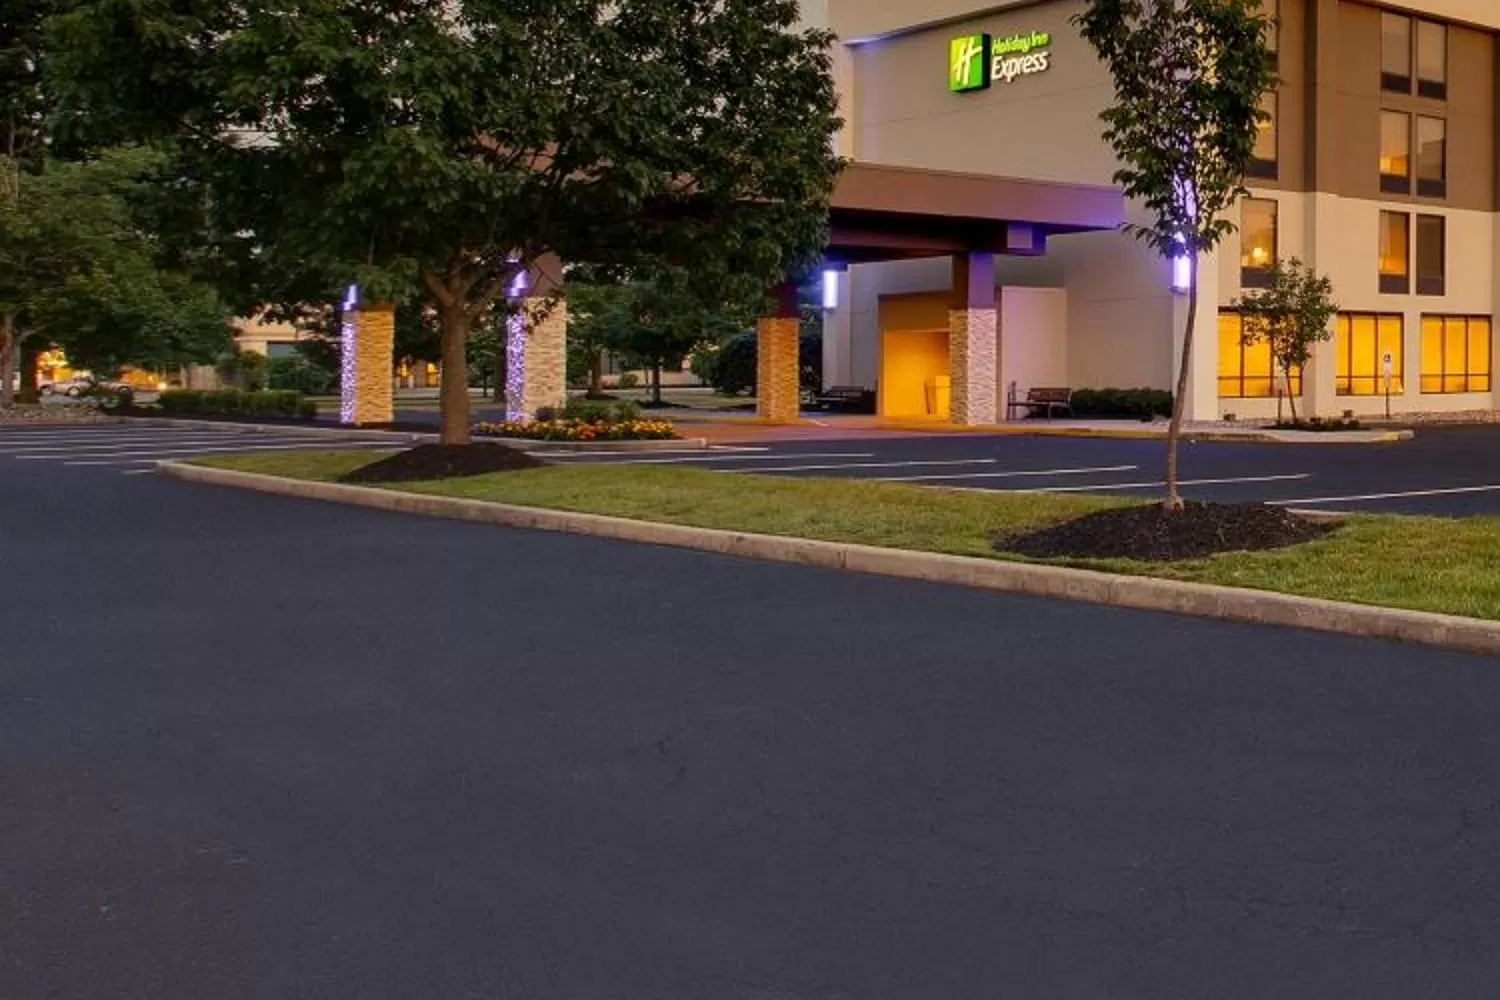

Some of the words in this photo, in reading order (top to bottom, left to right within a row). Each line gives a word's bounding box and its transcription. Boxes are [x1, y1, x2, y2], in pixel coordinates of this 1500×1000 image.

[992, 34, 1031, 55] Holiday
[1031, 30, 1049, 47] Inn
[991, 51, 1049, 82] Express
